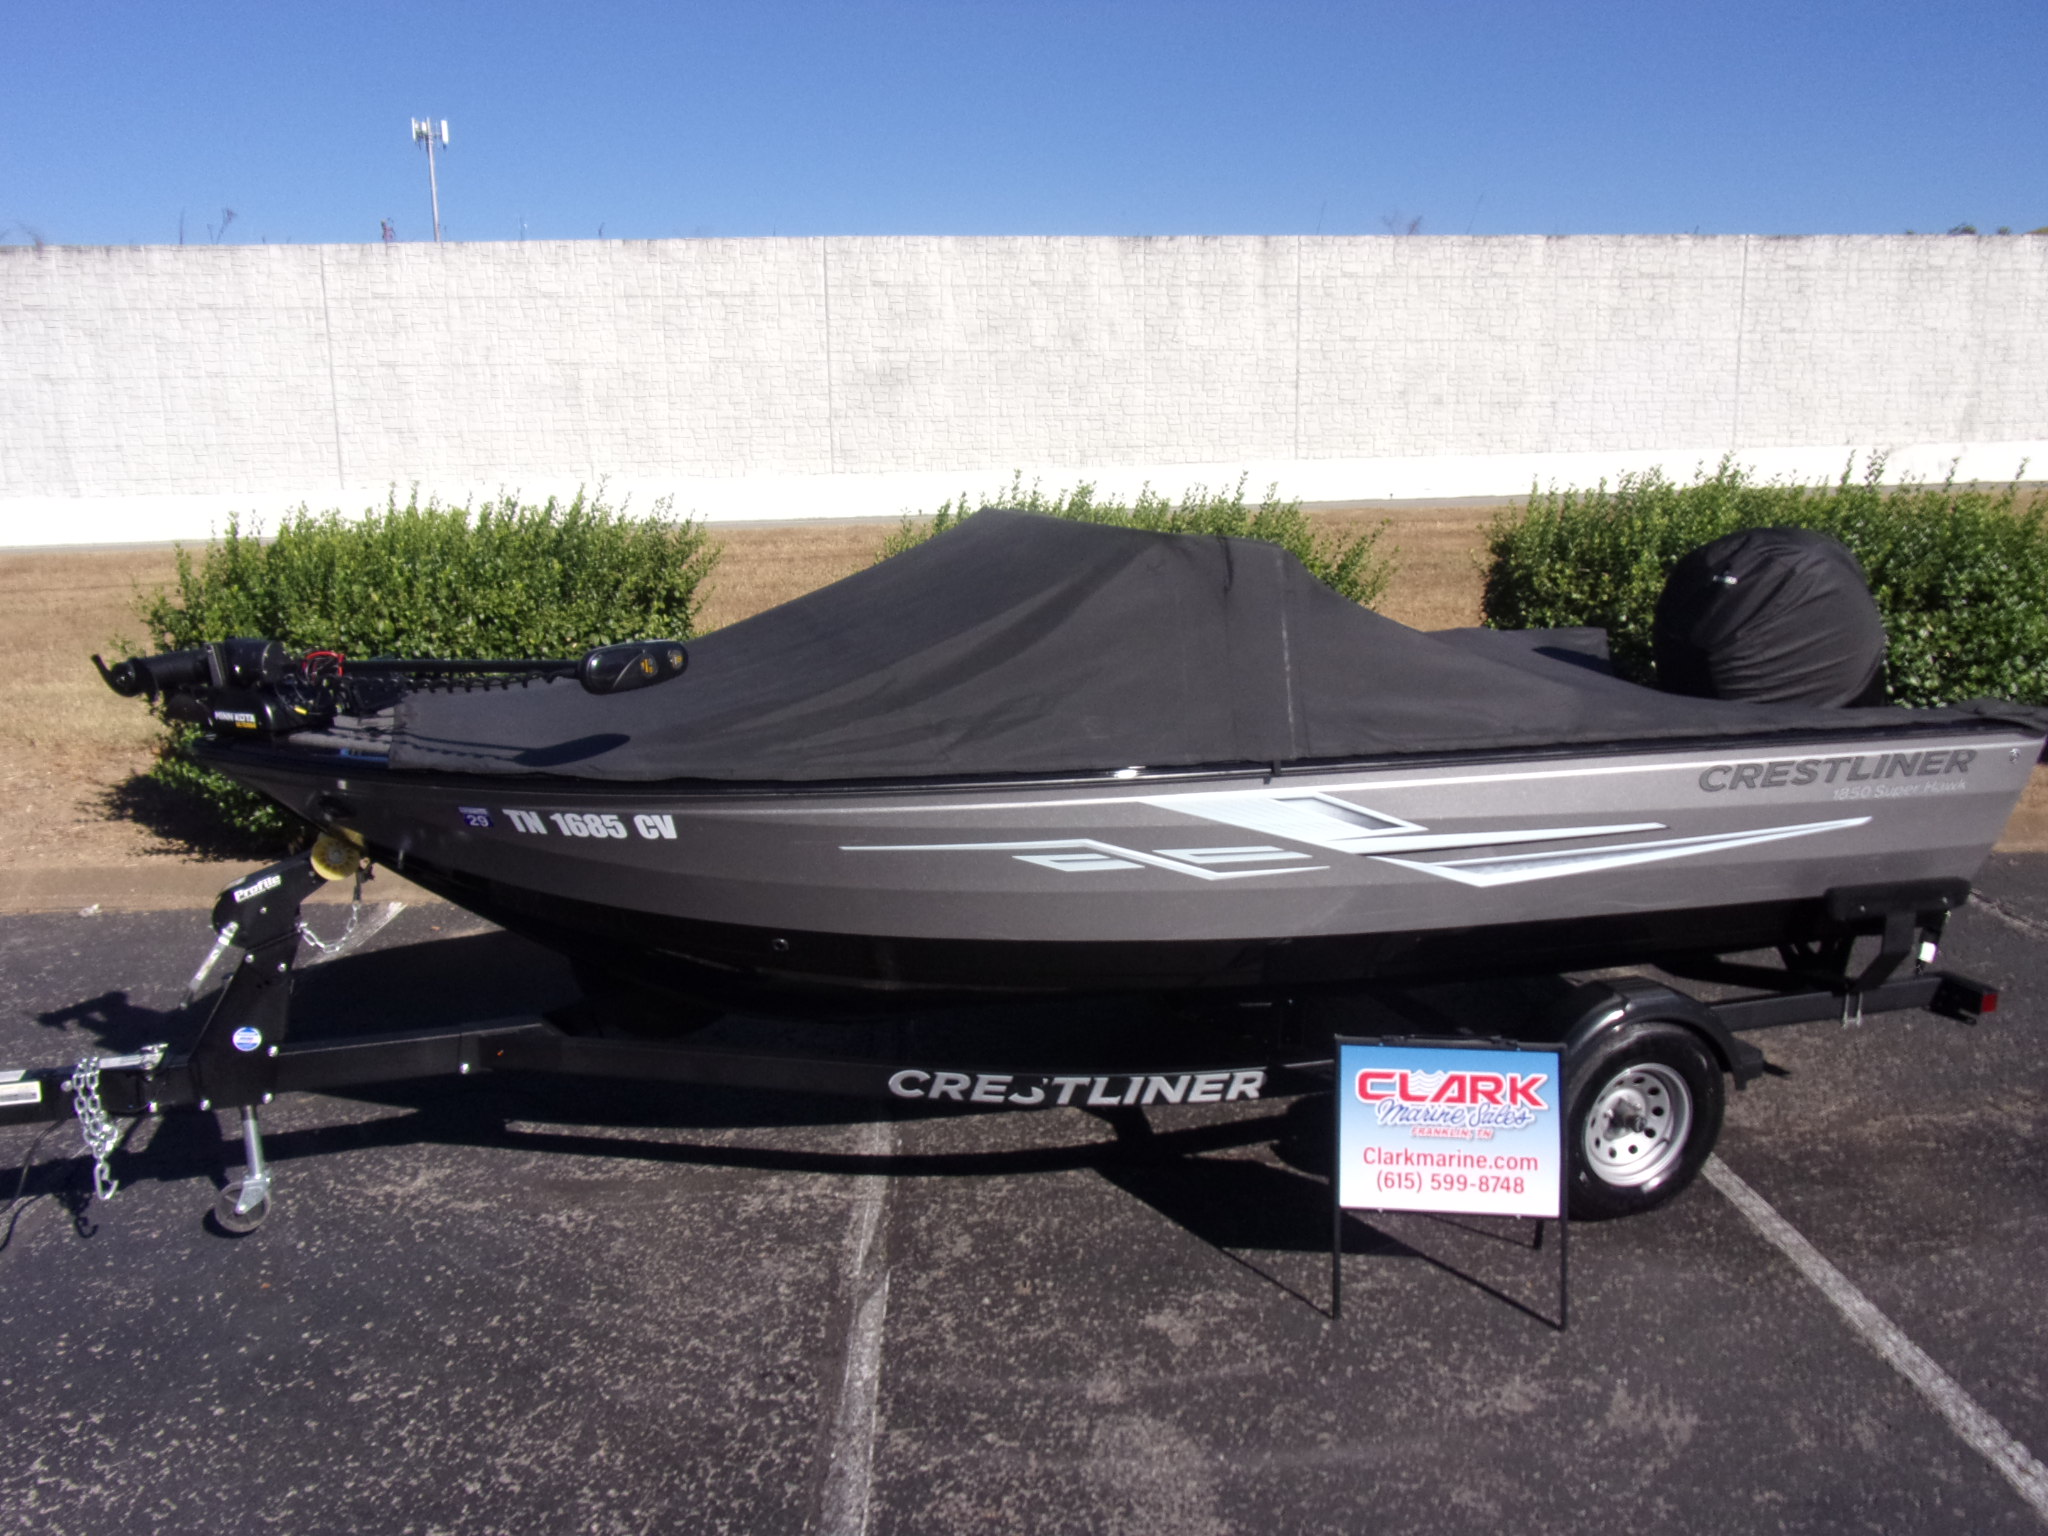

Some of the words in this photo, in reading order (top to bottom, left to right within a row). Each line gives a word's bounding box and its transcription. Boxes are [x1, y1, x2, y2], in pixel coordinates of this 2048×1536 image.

[1699, 749, 1978, 793] CRESTLINER
[1832, 785, 1872, 801] 1850
[1873, 783, 1920, 799] Super
[1923, 779, 1967, 793] Hawk
[466, 814, 489, 827] 29
[502, 808, 548, 835] TN
[550, 812, 628, 839] 1685
[633, 814, 678, 840] CV
[233, 874, 282, 903] Profile
[1357, 1070, 1547, 1108] CLARK
[1377, 1098, 1466, 1125] Marine
[1468, 1102, 1533, 1128] Sales
[1362, 1146, 1539, 1172] Clarkmarine.com
[1376, 1169, 1422, 1194] (615)
[1430, 1173, 1525, 1195] 599-8748
